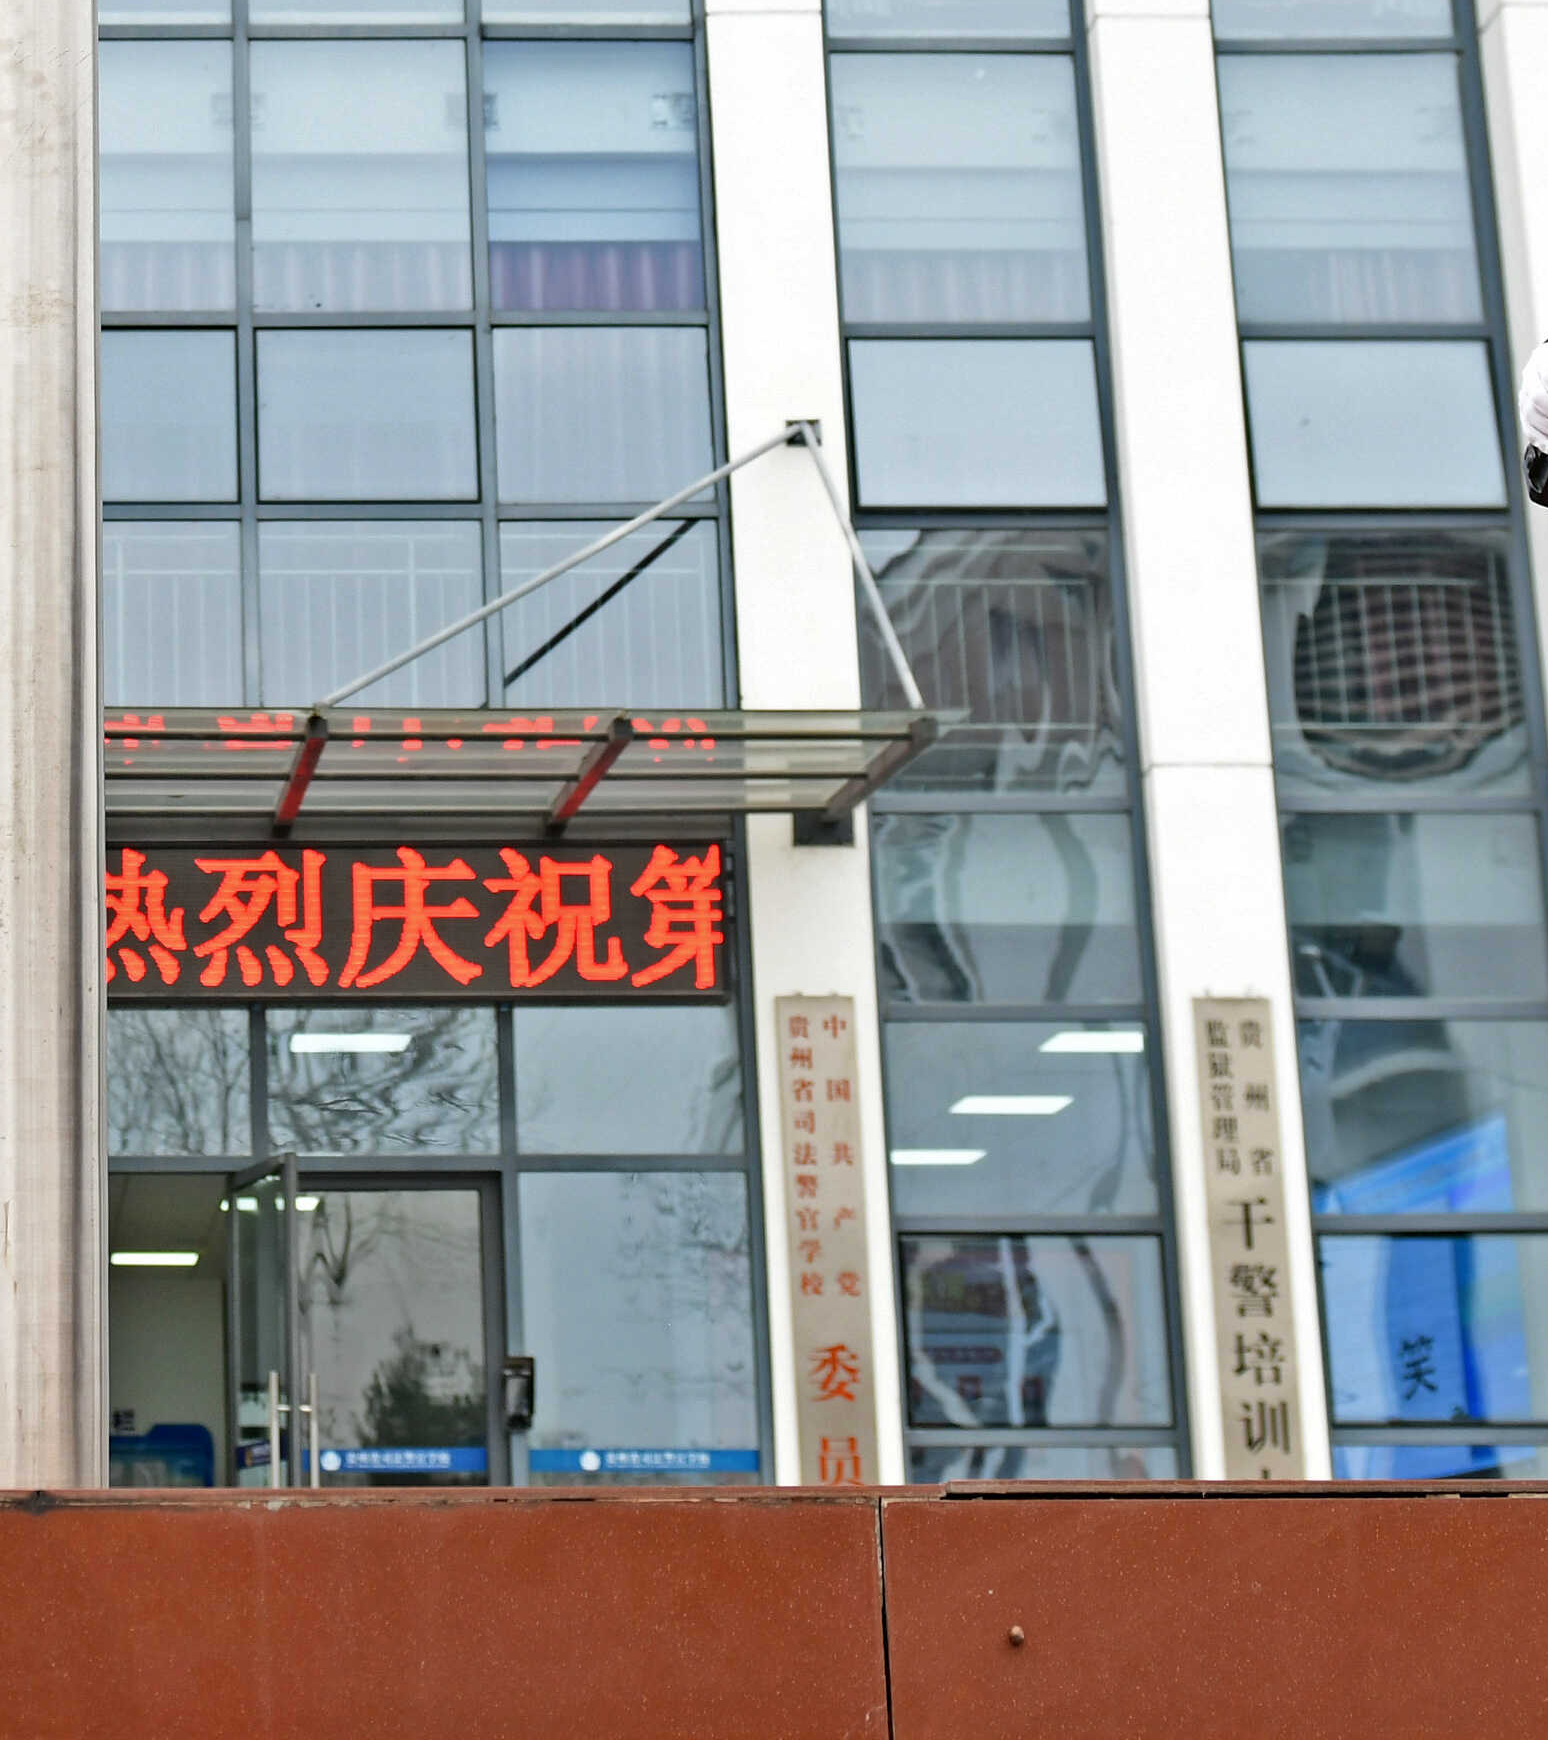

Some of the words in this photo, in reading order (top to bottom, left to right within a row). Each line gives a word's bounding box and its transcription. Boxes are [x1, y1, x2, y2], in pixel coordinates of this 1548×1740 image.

[788, 1015, 823, 1296] 贵州省司法警官学校
[822, 1013, 861, 1297] 中国共产党
[1206, 1019, 1242, 1176] 监狱管理局
[1239, 1019, 1274, 1176] 贵州省
[809, 1343, 864, 1486] 委员
[1222, 1196, 1291, 1479] 干警培训
